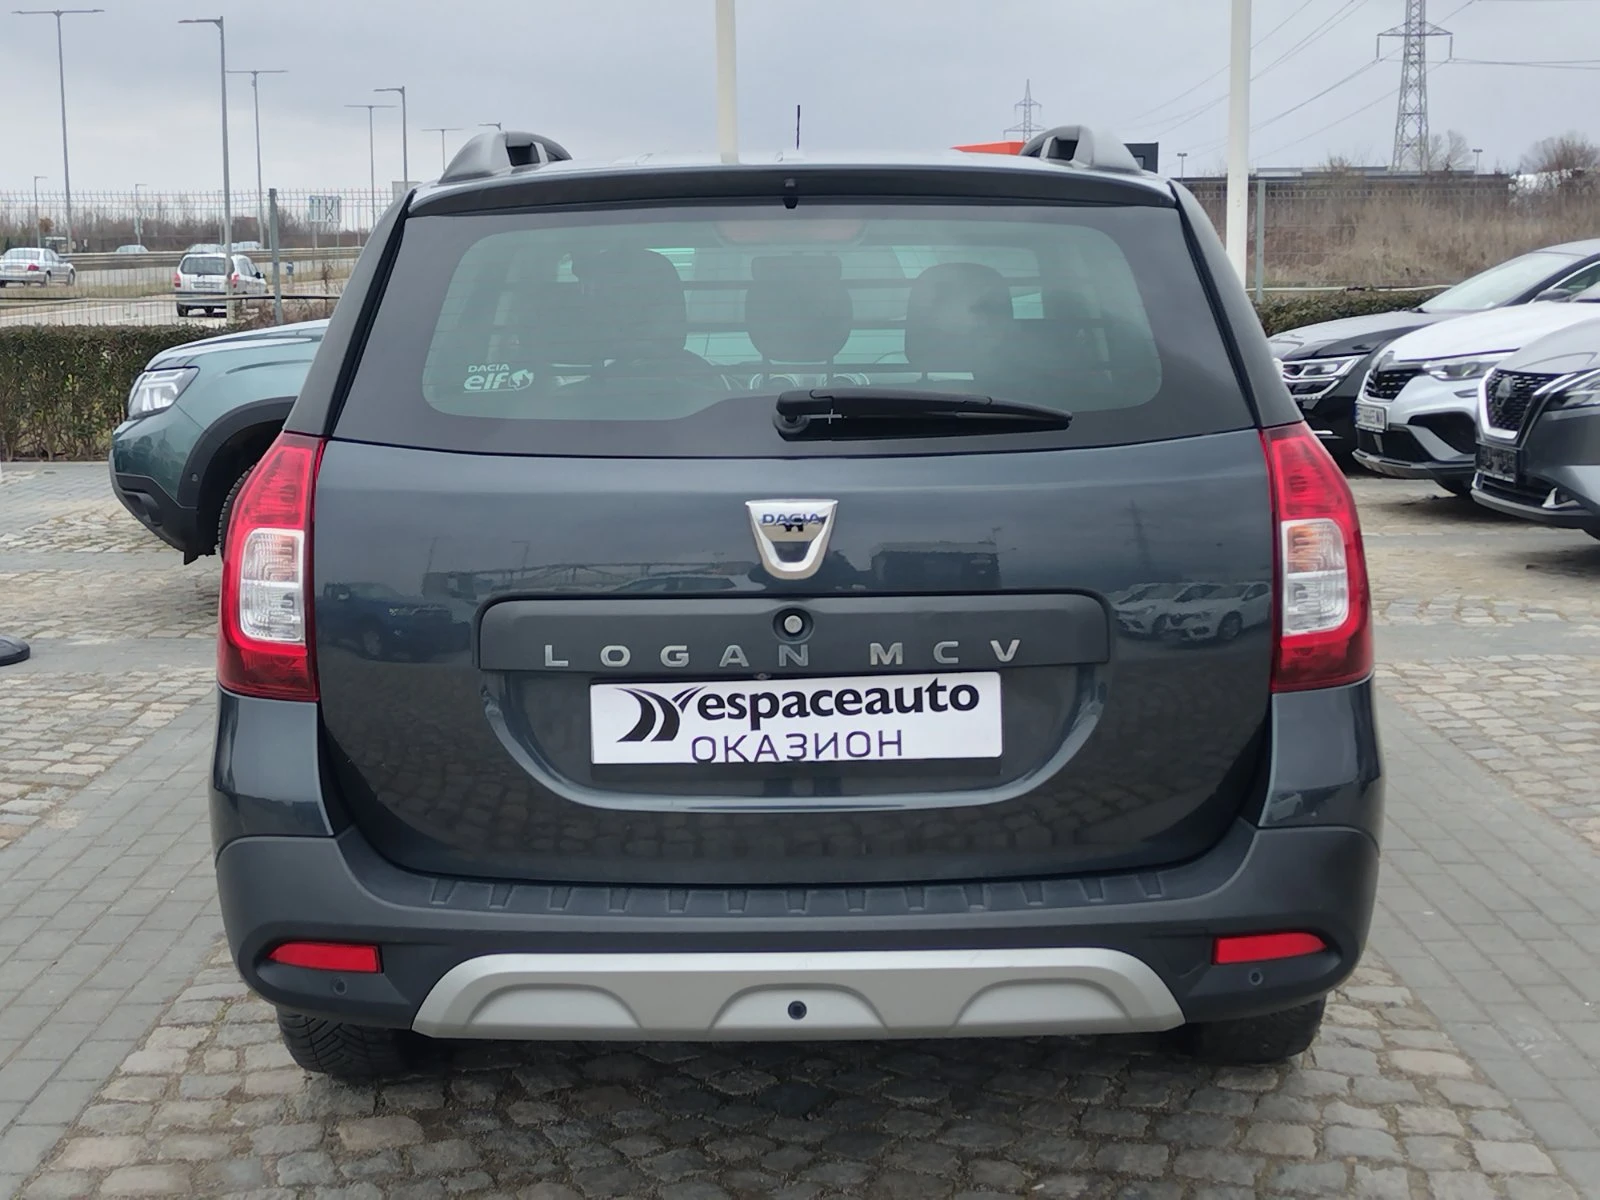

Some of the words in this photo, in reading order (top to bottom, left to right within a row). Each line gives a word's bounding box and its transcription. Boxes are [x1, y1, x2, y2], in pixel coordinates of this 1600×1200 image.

[467, 363, 510, 373] DACIA
[463, 372, 510, 390] elf
[762, 513, 821, 525] DACIA
[544, 644, 809, 668] LOGAN
[869, 639, 1021, 666] MCV
[697, 677, 980, 731] espaceauto
[691, 729, 903, 763] ОКАЗИОН
